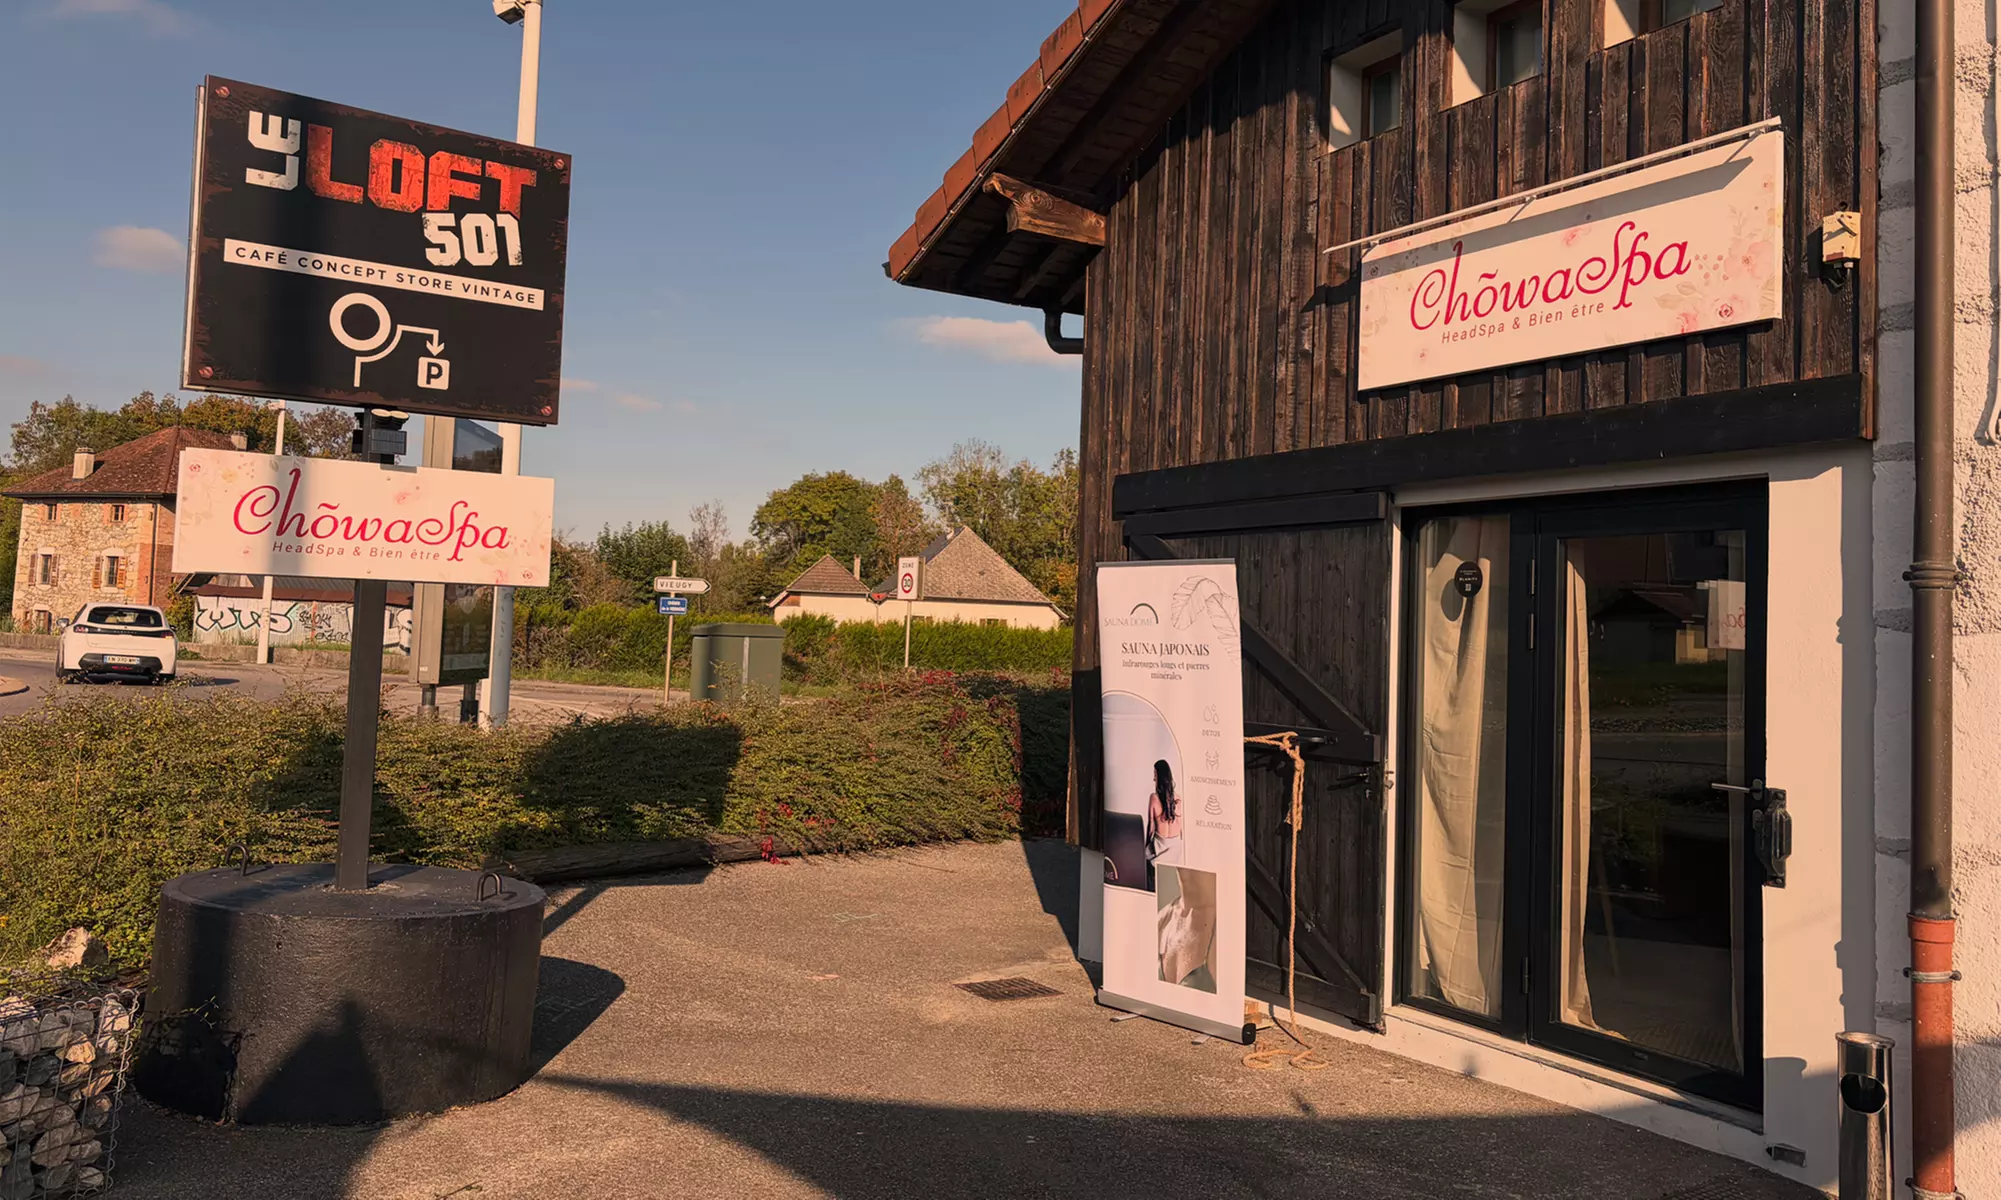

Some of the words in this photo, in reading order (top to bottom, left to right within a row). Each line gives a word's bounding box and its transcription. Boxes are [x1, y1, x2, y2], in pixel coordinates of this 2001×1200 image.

[305, 123, 537, 218] LOFT
[422, 212, 523, 266] 501
[235, 246, 288, 265] CAFÉ
[298, 257, 386, 281] CONCEPT
[396, 272, 453, 291] STORE
[462, 282, 536, 304] VINTAGE
[1441, 320, 1505, 344] HeadSpa
[1512, 316, 1521, 330] &
[1528, 309, 1564, 327] Bien
[1571, 301, 1605, 319] être
[272, 541, 345, 557] HeadSpa
[352, 546, 361, 556] &
[369, 546, 403, 560] Bien
[660, 581, 693, 589] VIEUGY
[1104, 617, 1129, 627] SAUNA
[1121, 642, 1157, 656] SAUNA
[1159, 643, 1210, 657] JAPONAIS
[1178, 661, 1185, 669] et
[1186, 661, 1210, 672] pierres
[1196, 819, 1232, 831] RELAXATION
